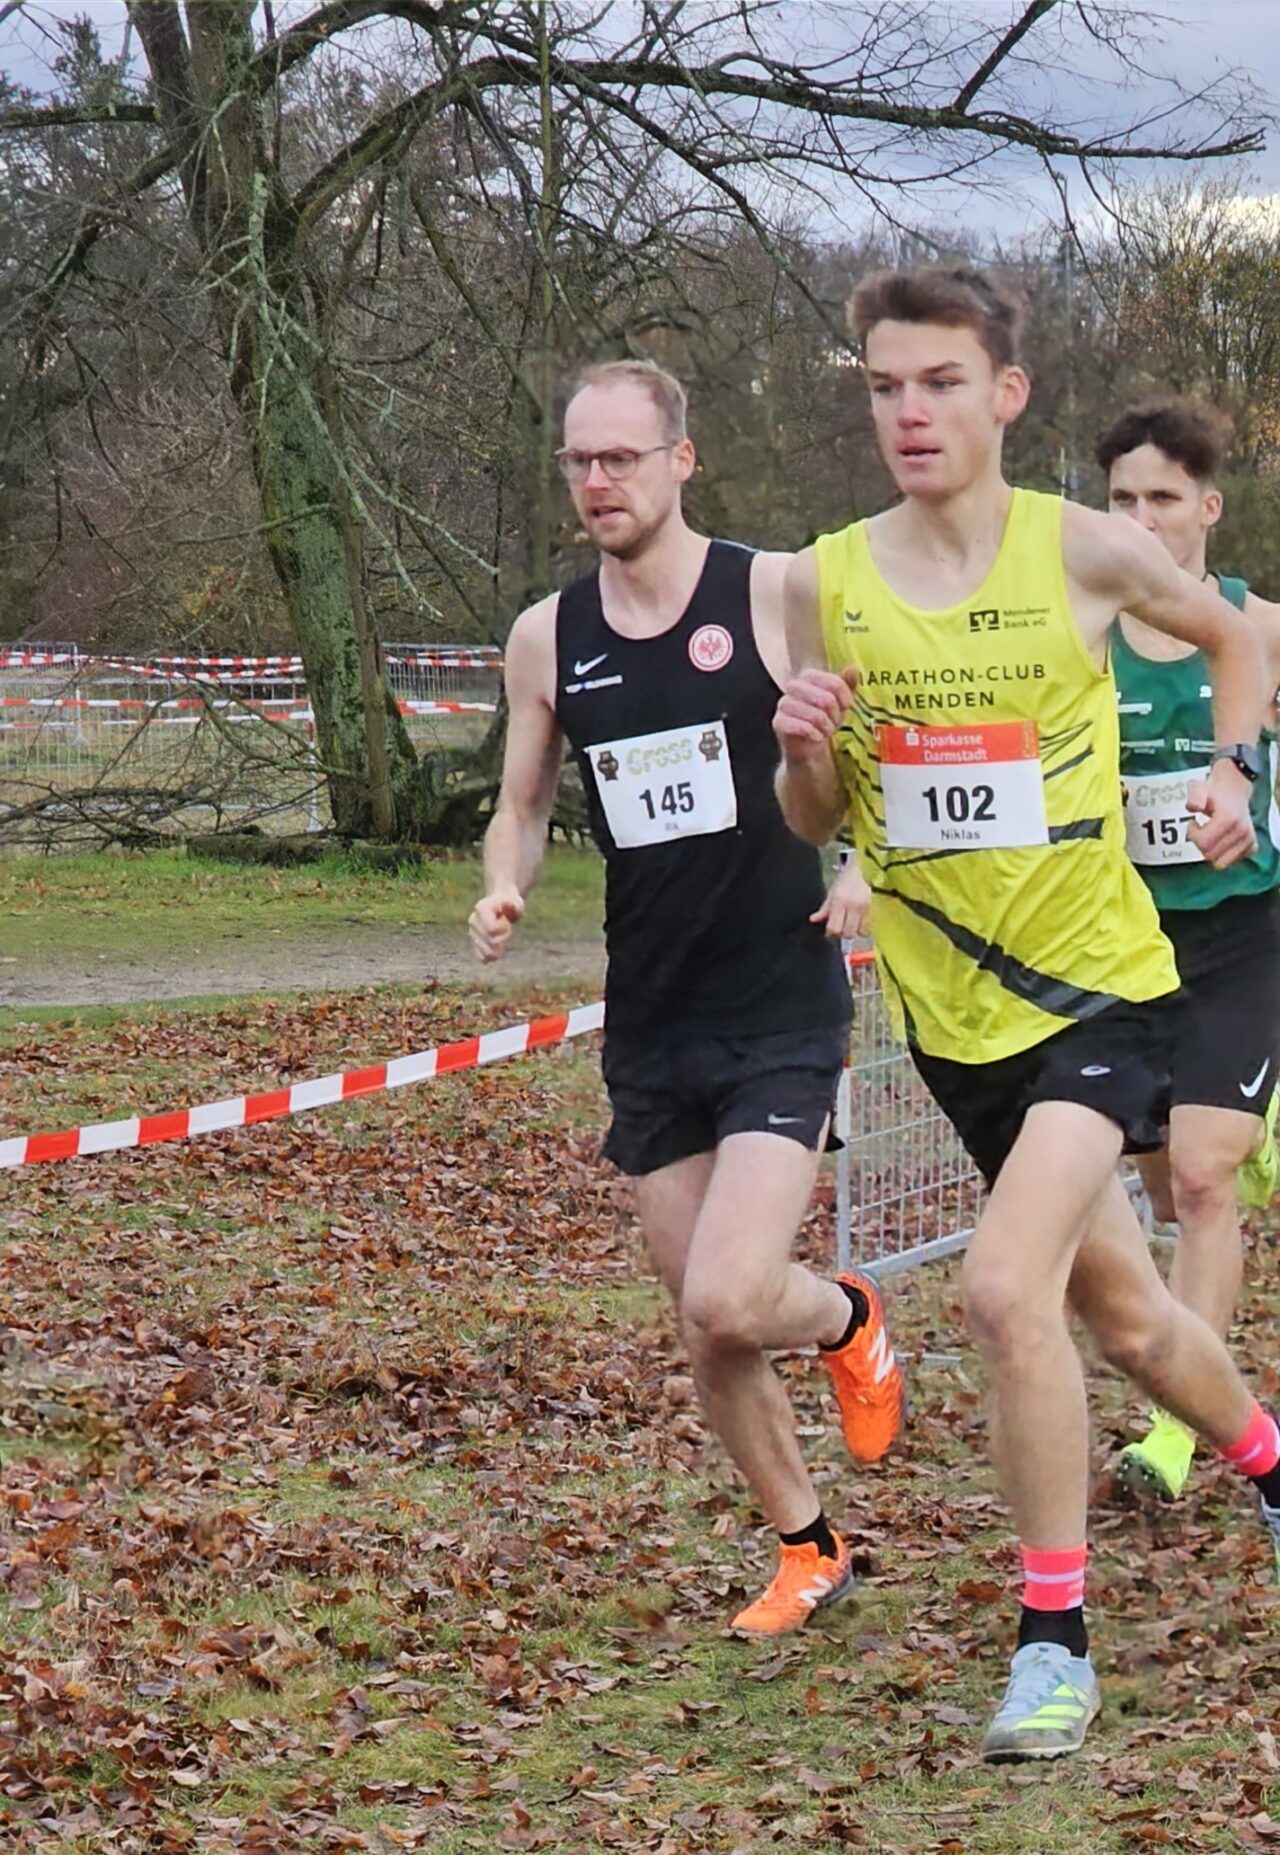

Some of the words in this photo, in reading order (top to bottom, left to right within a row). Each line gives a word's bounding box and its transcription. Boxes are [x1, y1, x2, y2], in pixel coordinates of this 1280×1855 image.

[894, 690, 995, 710] MENDEN
[921, 733, 984, 749] Sparkasse
[626, 738, 694, 776] Cross
[924, 748, 988, 763] Darmstadt
[639, 781, 695, 820] 145
[922, 784, 997, 823] 102
[1135, 779, 1194, 808] Cros
[940, 828, 981, 841] Niklas
